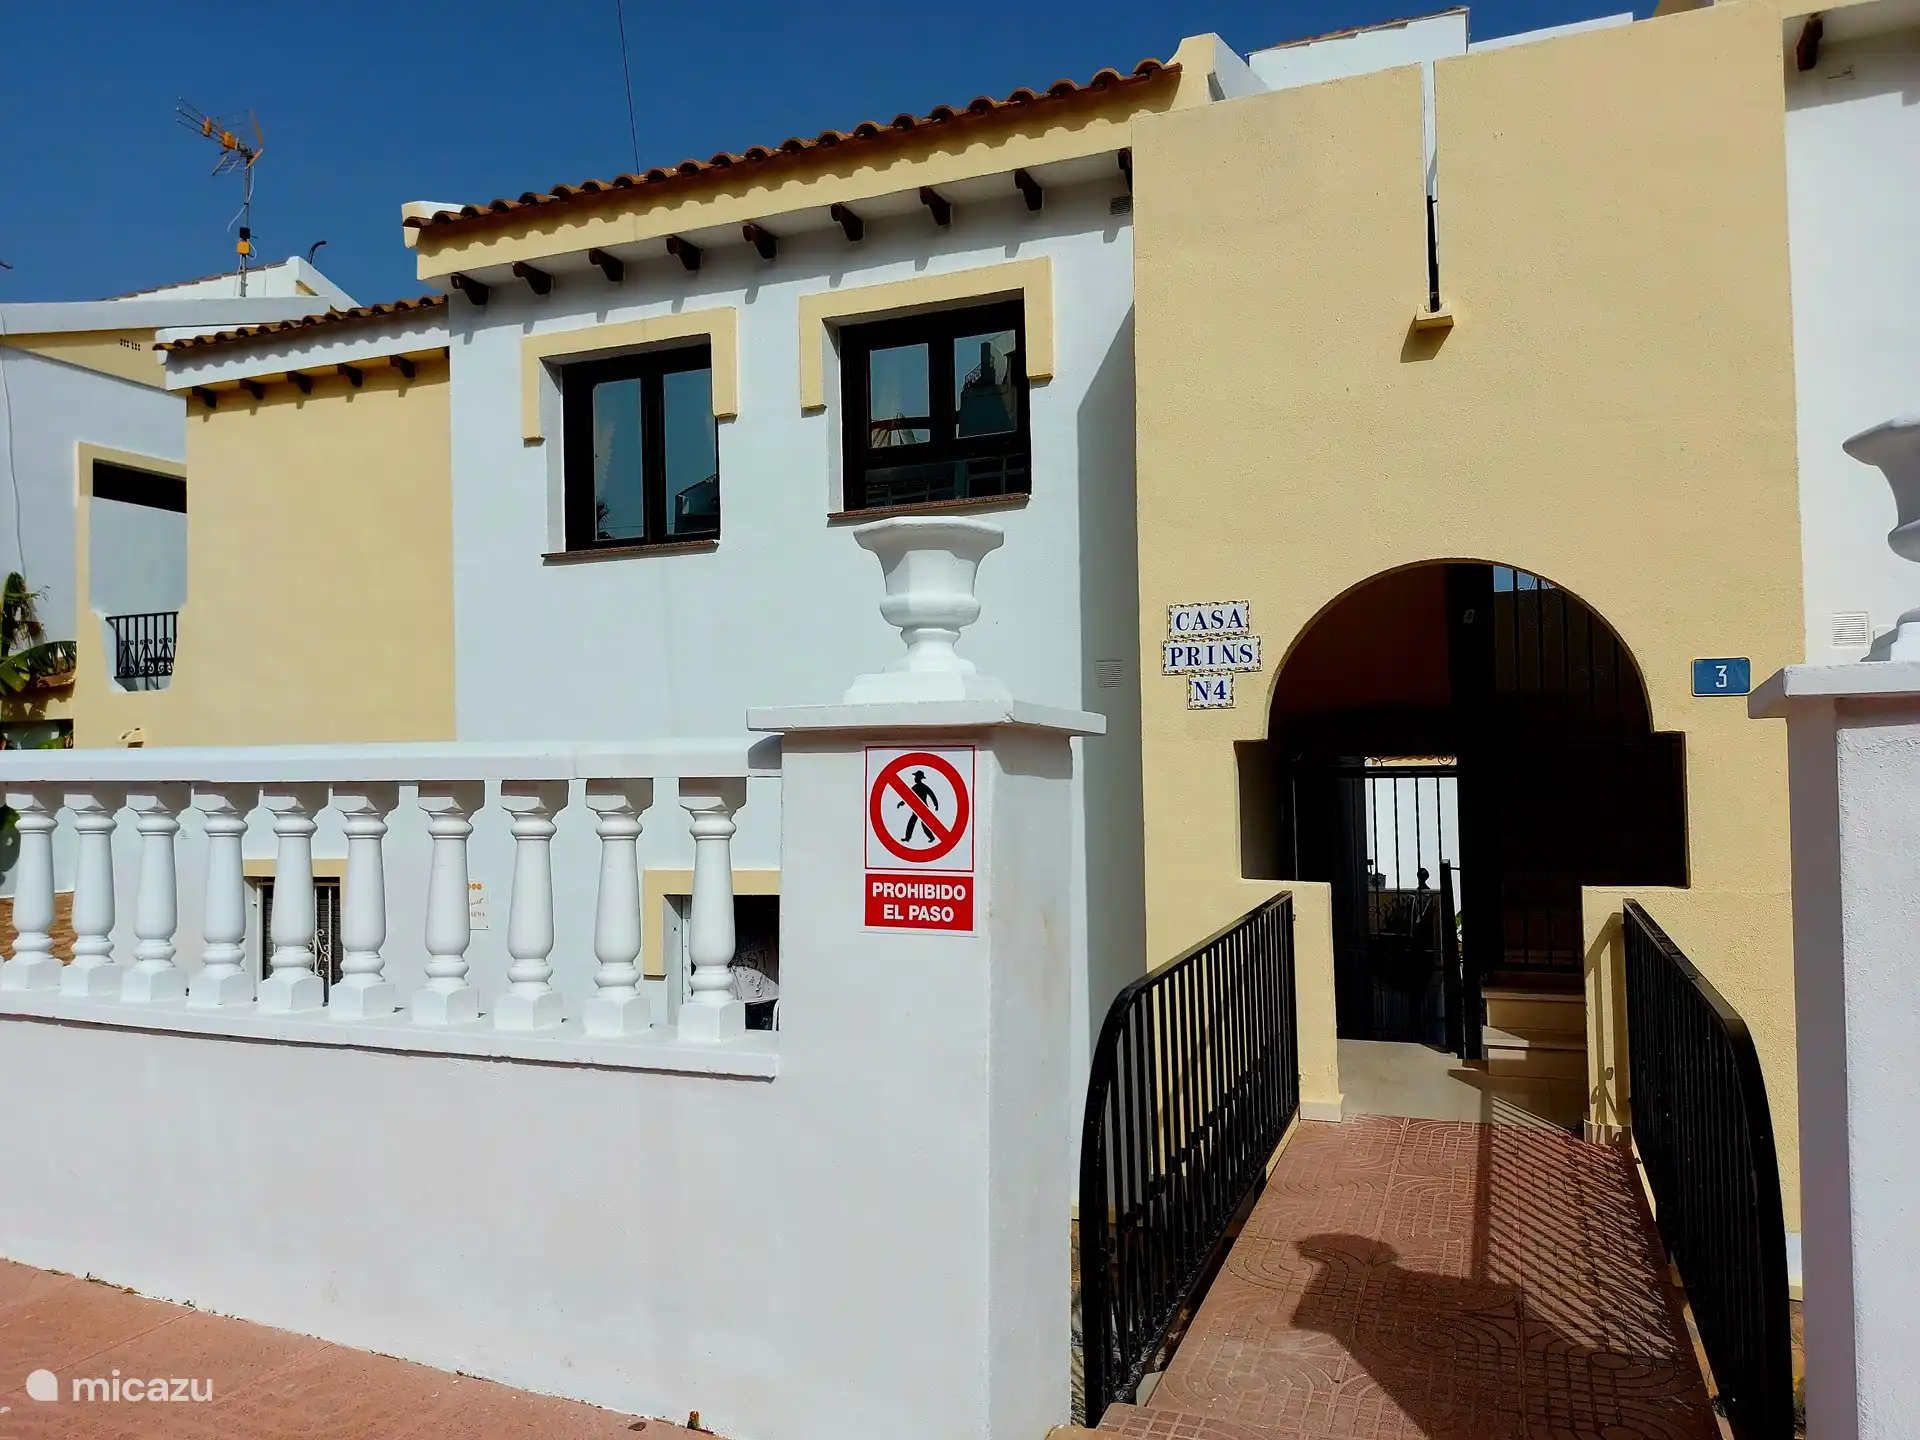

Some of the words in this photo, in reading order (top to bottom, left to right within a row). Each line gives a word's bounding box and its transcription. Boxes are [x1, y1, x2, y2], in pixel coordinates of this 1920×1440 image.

[1175, 608, 1244, 631] CASA
[1168, 643, 1253, 667] PRINS
[1715, 665, 1727, 688] 3
[872, 882, 966, 900] PROHIBIDO
[883, 904, 904, 920] EL
[908, 905, 955, 923] PASO
